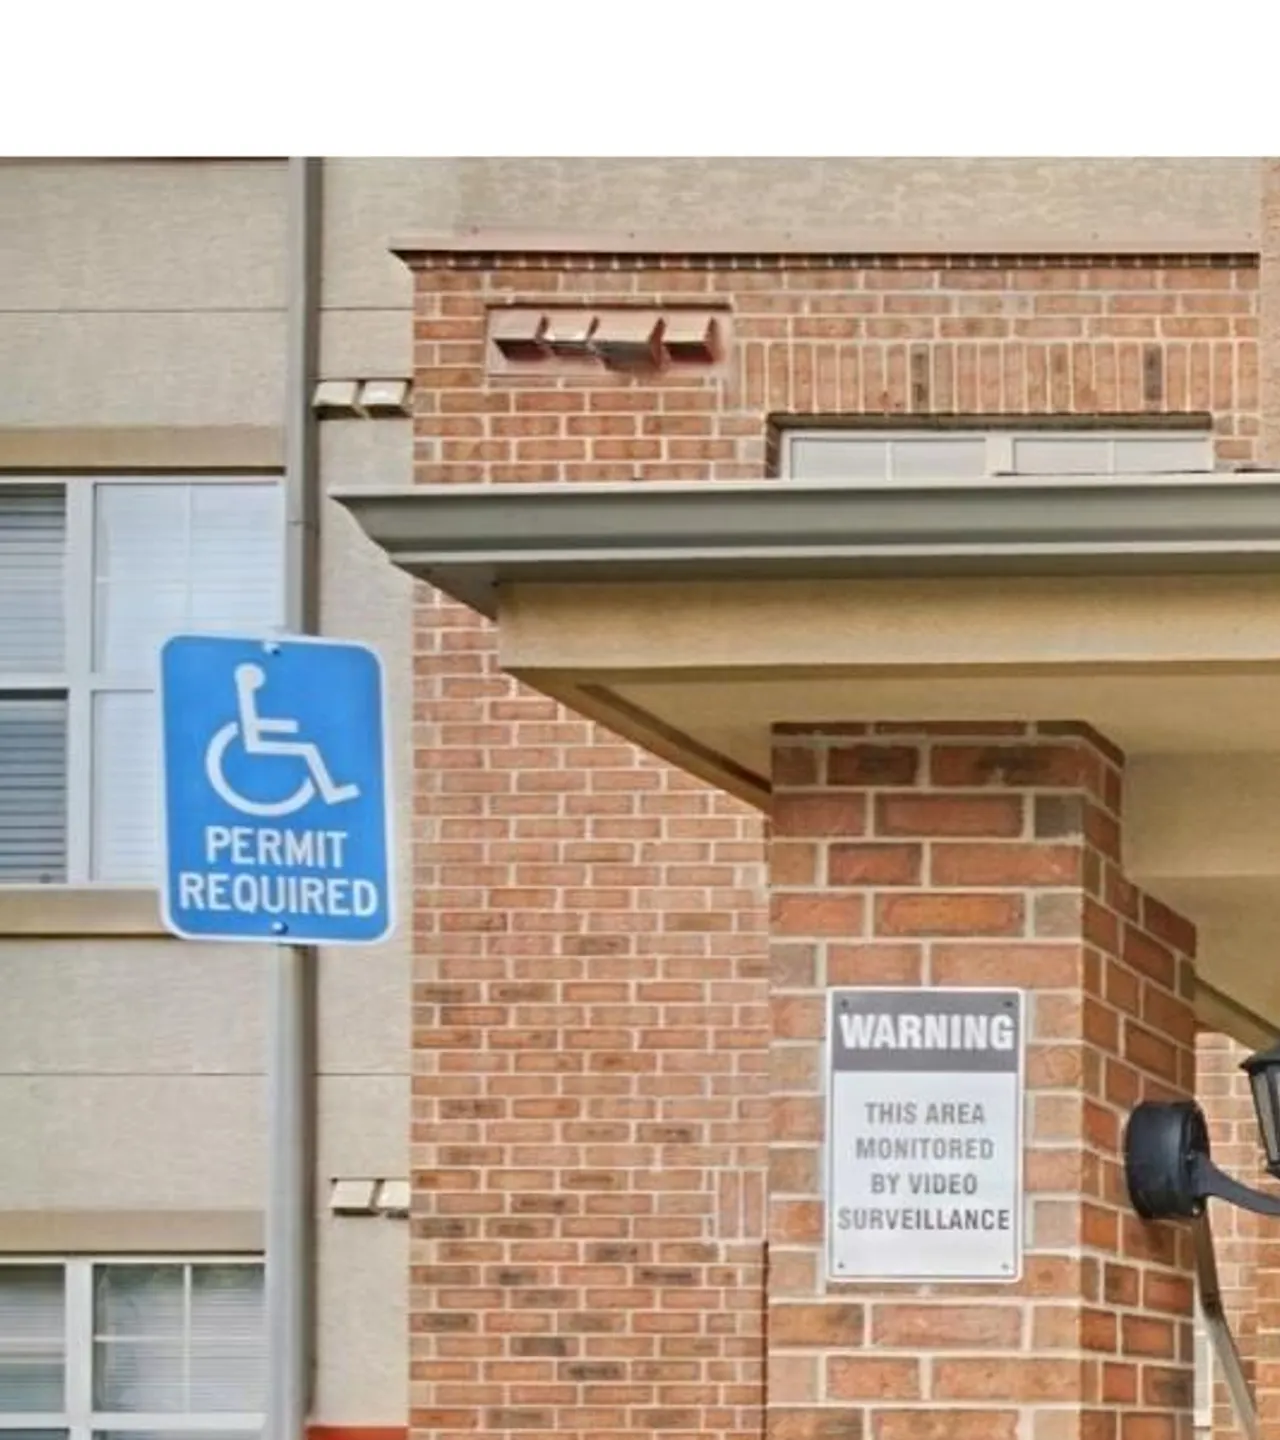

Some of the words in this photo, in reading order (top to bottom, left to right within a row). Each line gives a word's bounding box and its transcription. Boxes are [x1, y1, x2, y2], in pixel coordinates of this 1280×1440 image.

[205, 825, 348, 868] PERMIT
[178, 871, 379, 918] REQUIRED
[838, 1012, 1016, 1051] WARNING
[864, 1102, 918, 1125] THIS
[924, 1102, 986, 1125] AREA
[854, 1137, 995, 1161] MONITORED
[870, 1172, 901, 1196] BY
[908, 1172, 978, 1196] VIDEO
[837, 1208, 1012, 1232] SURVEILLANCE
